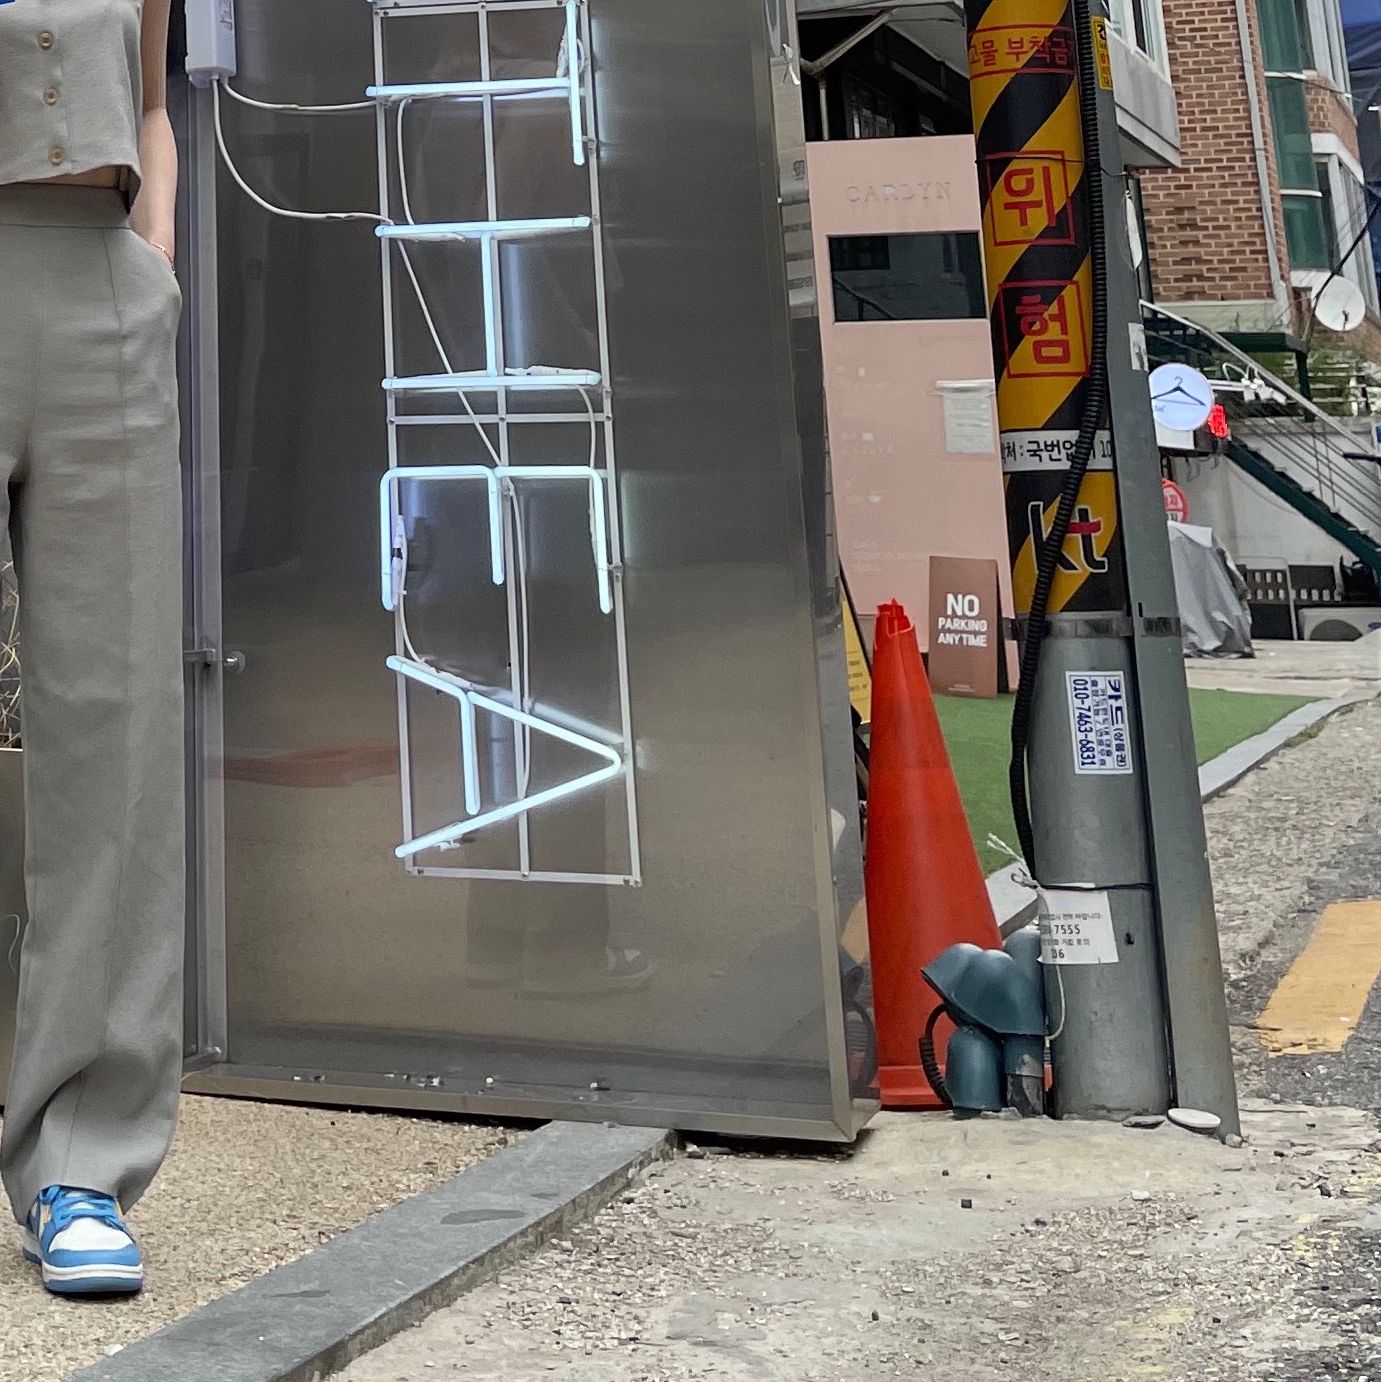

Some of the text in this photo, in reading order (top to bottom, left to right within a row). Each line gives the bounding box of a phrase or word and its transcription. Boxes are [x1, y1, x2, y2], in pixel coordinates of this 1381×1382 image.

[845, 182, 951, 203] CARLYN
[946, 592, 980, 617] NO
[937, 617, 988, 632] PARKING
[1073, 678, 1097, 767] 010-7463-6831
